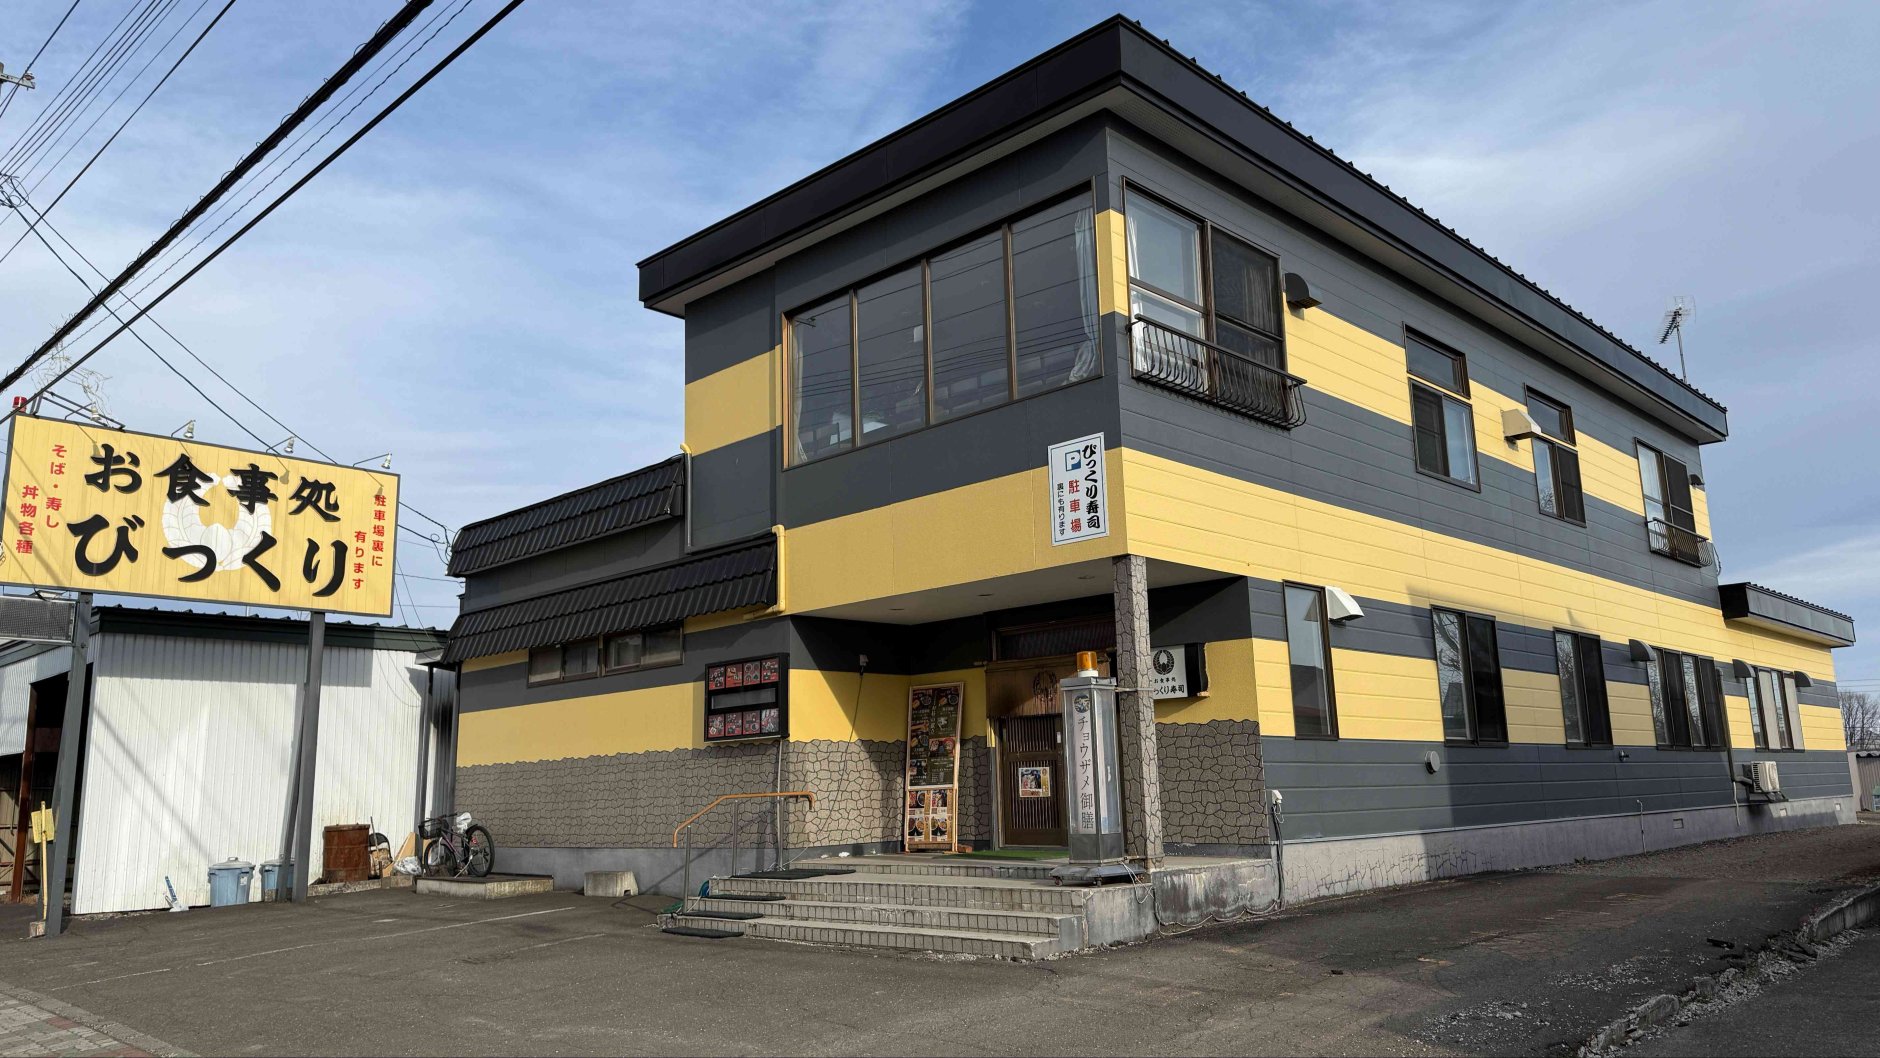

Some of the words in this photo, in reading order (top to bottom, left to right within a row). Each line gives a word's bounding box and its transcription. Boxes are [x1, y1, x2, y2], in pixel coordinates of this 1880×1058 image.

[84, 443, 341, 523] お食事処
[1068, 479, 1082, 533] 駐車場
[16, 485, 39, 555] 丼物各種
[371, 494, 387, 567] 駐車場裏に
[352, 530, 367, 590] 有ります
[1153, 684, 1185, 695] っくり寿司
[1078, 716, 1095, 829] チョウザメ御膳
